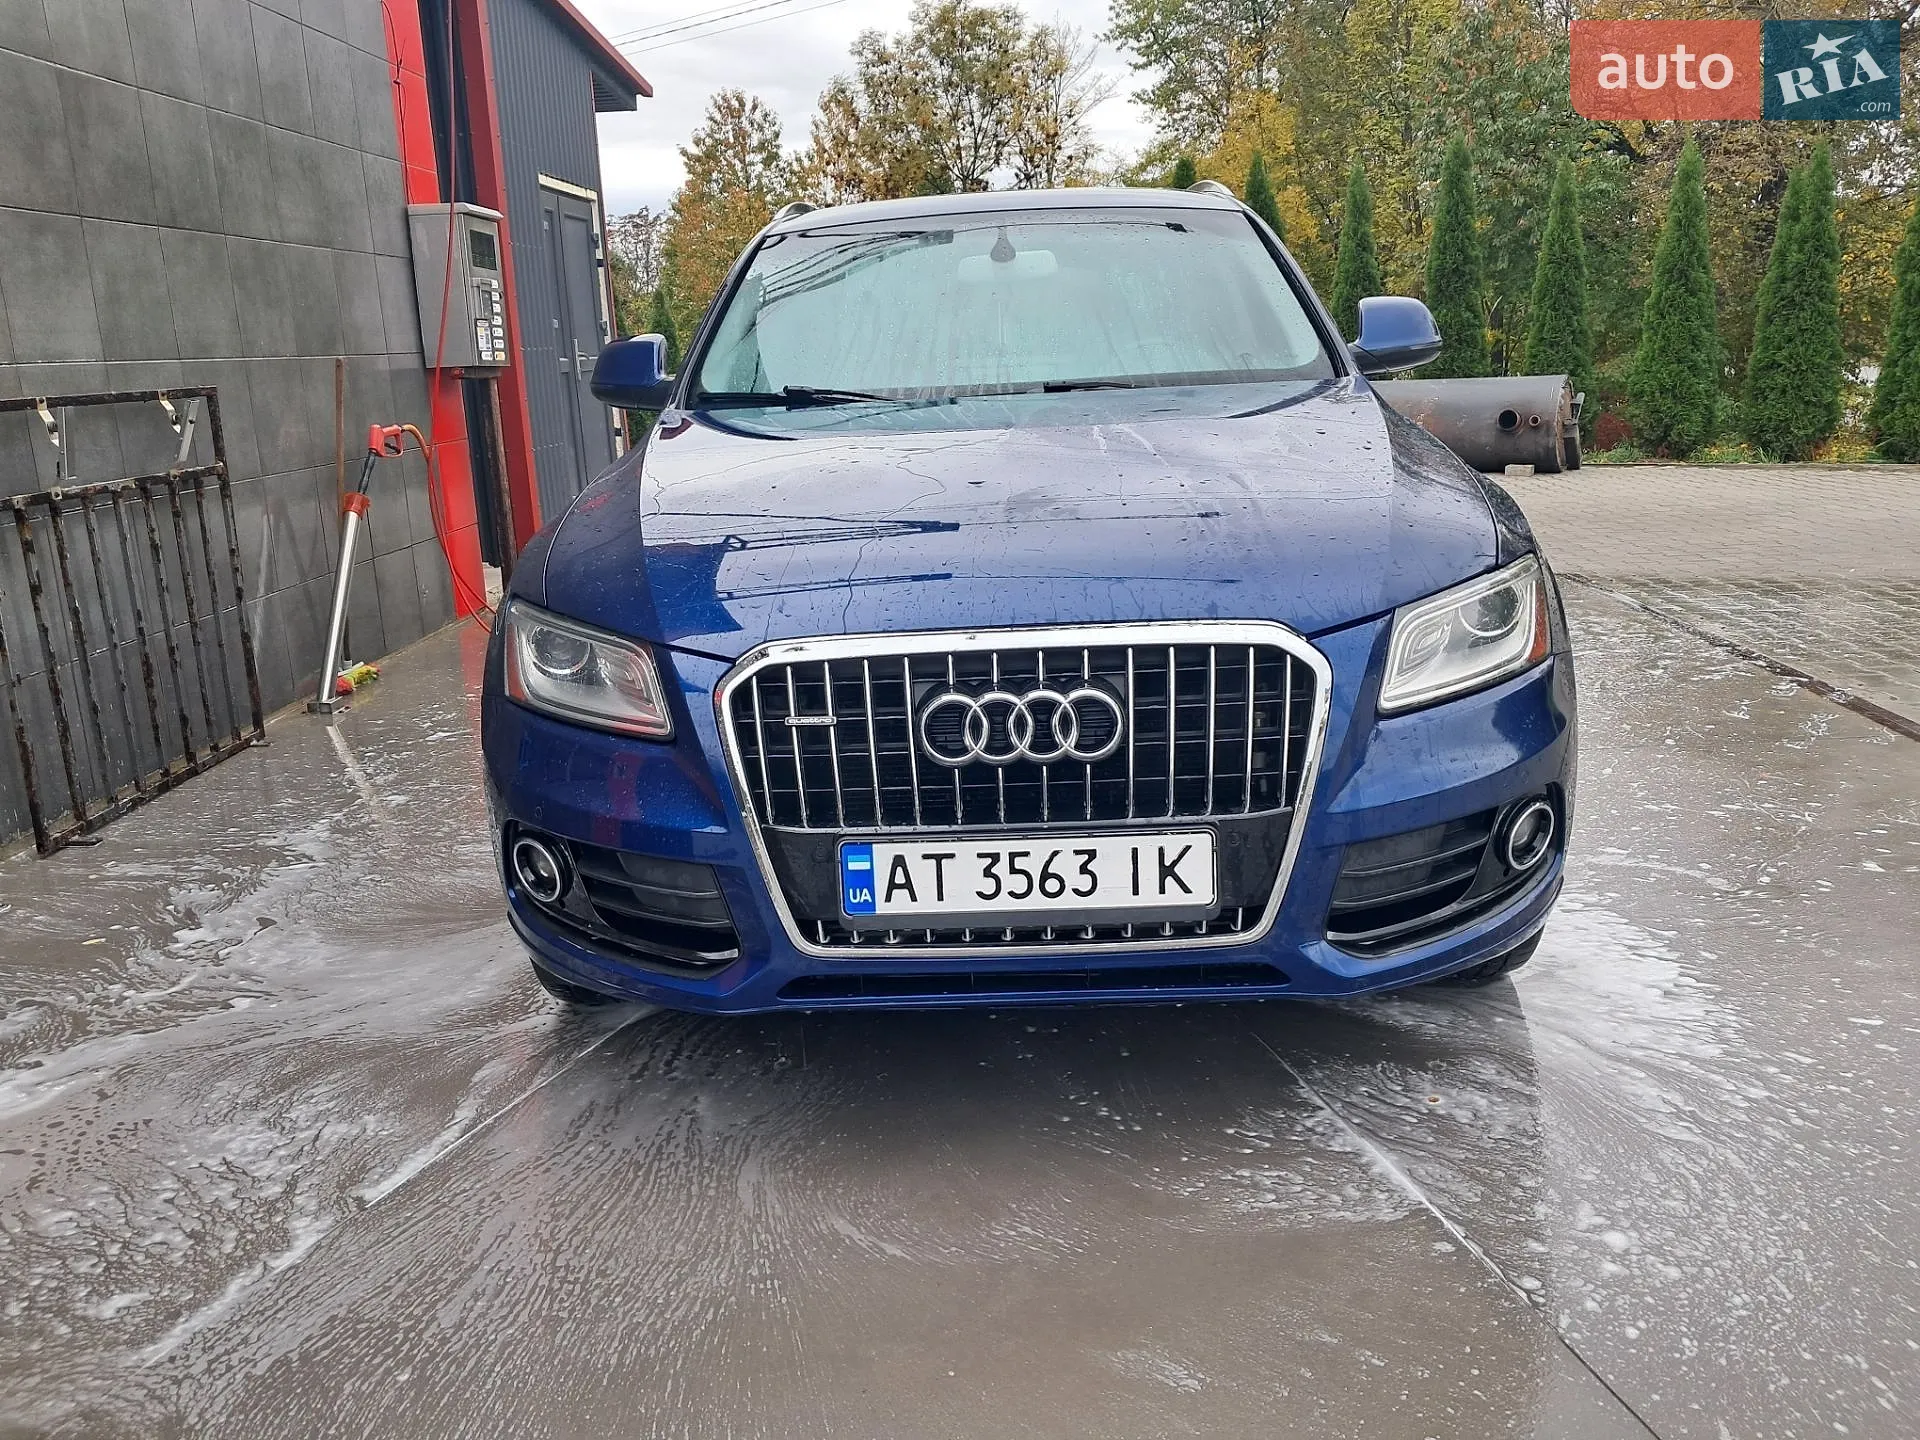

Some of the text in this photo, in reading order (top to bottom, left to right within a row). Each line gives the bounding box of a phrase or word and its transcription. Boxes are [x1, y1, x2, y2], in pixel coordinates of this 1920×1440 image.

[884, 844, 1193, 903] AT 3563 IK
[849, 888, 872, 903] UA
